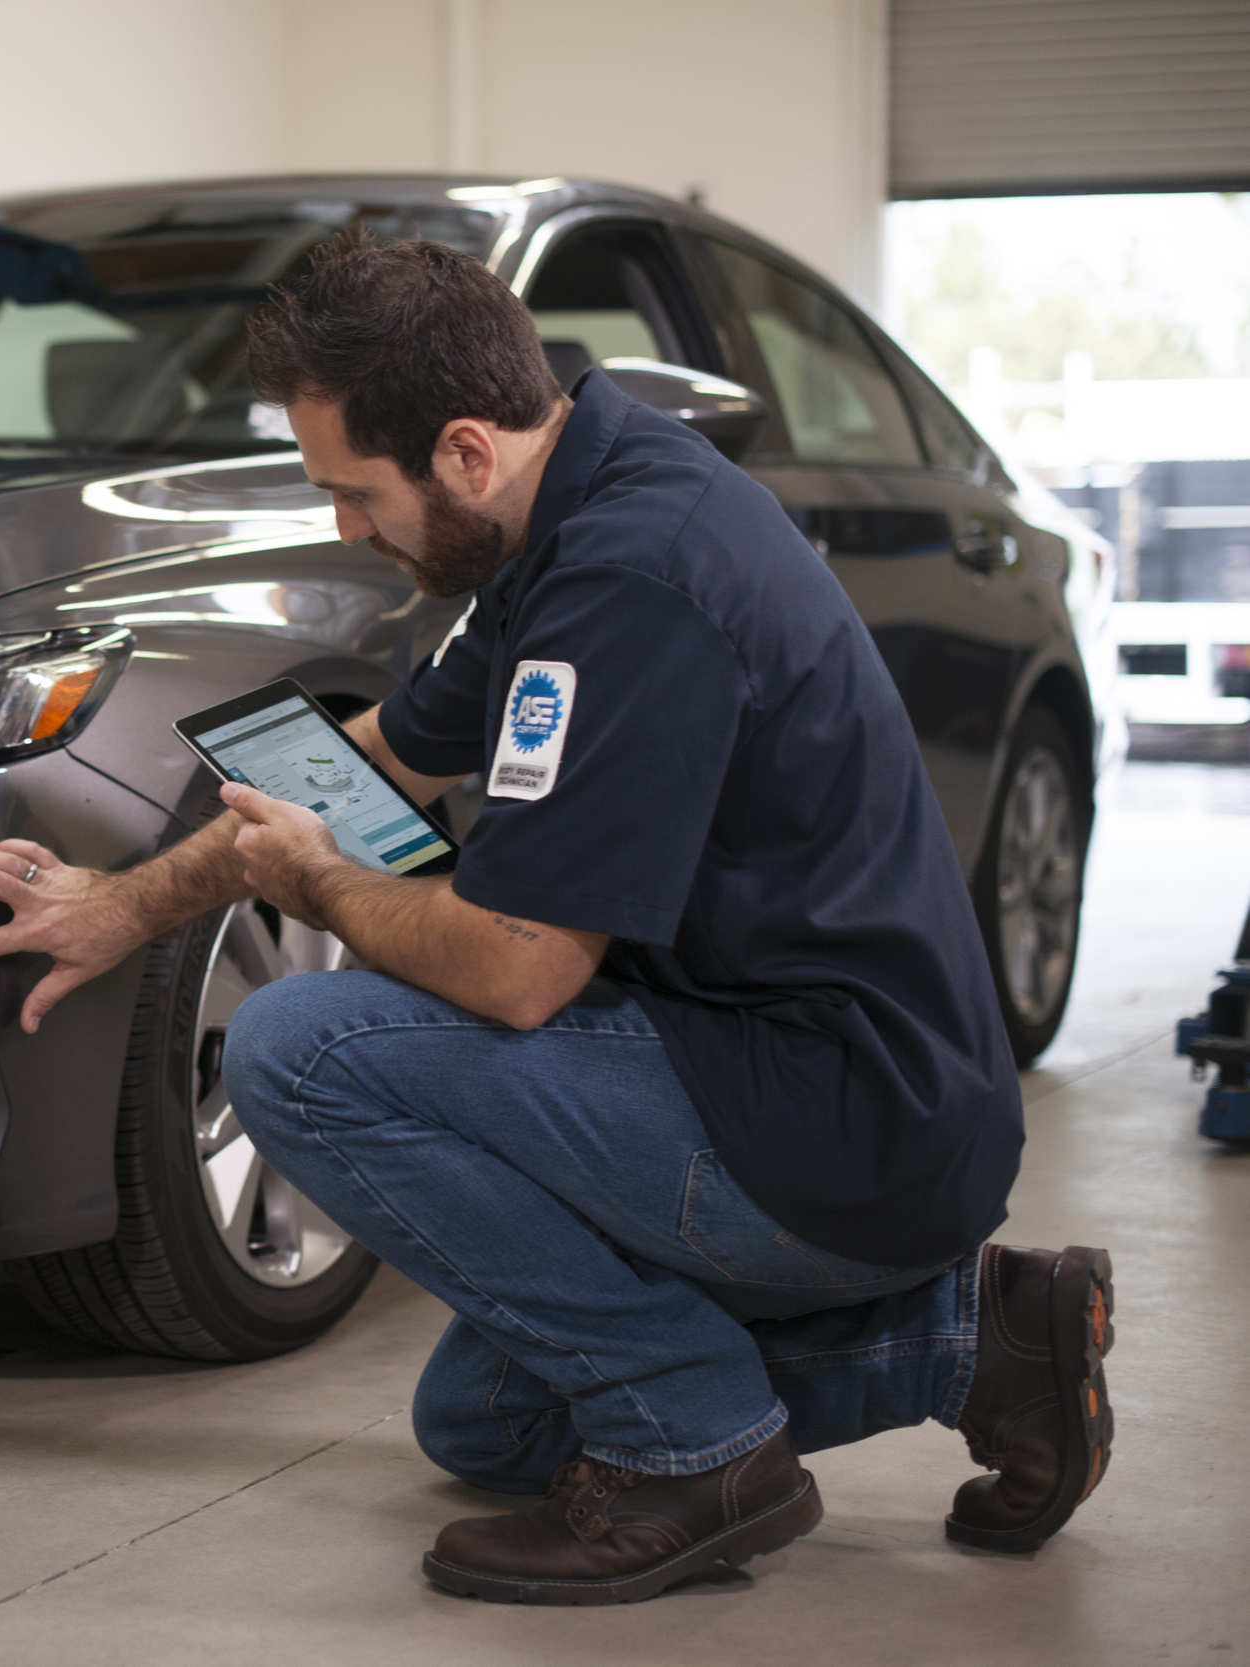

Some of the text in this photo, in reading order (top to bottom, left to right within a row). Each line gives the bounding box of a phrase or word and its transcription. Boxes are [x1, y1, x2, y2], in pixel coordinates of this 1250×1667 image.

[515, 696, 555, 725] ASE
[517, 725, 548, 734] CERTIFIED
[517, 768, 545, 778] REPAIR
